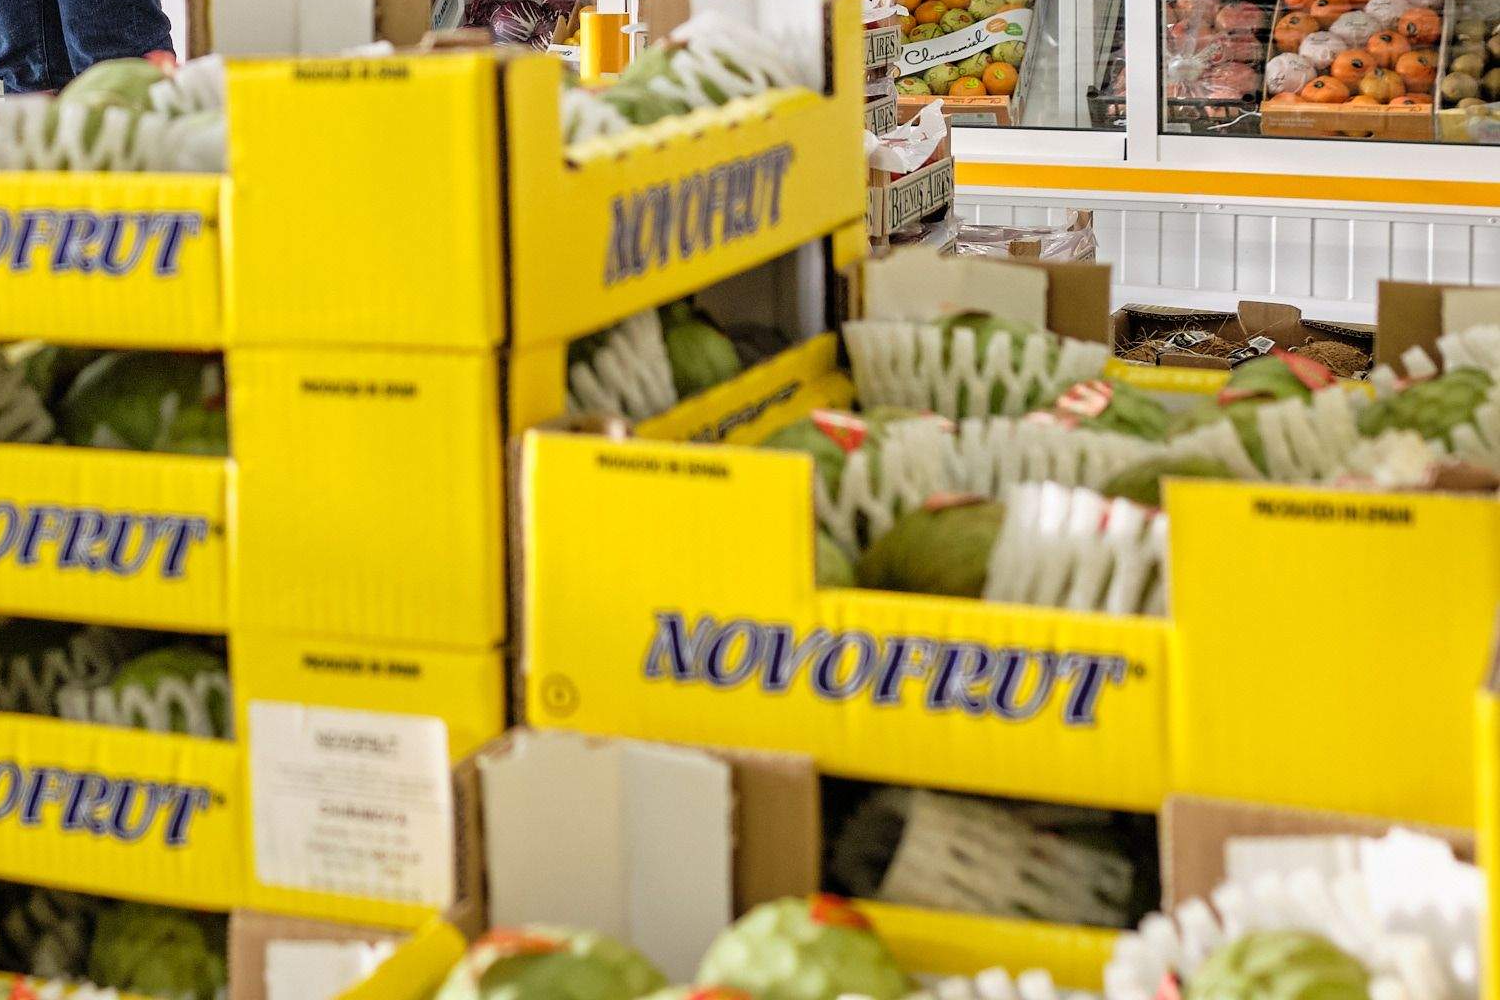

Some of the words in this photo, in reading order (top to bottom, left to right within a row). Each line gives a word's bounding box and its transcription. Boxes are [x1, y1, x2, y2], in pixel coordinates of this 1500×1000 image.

[866, 33, 895, 66] AIRES
[603, 143, 794, 287] NOVOFRUT
[891, 182, 924, 229] BUENOS
[925, 168, 950, 211] AIRES
[644, 611, 1124, 725] NOVOFRUT
